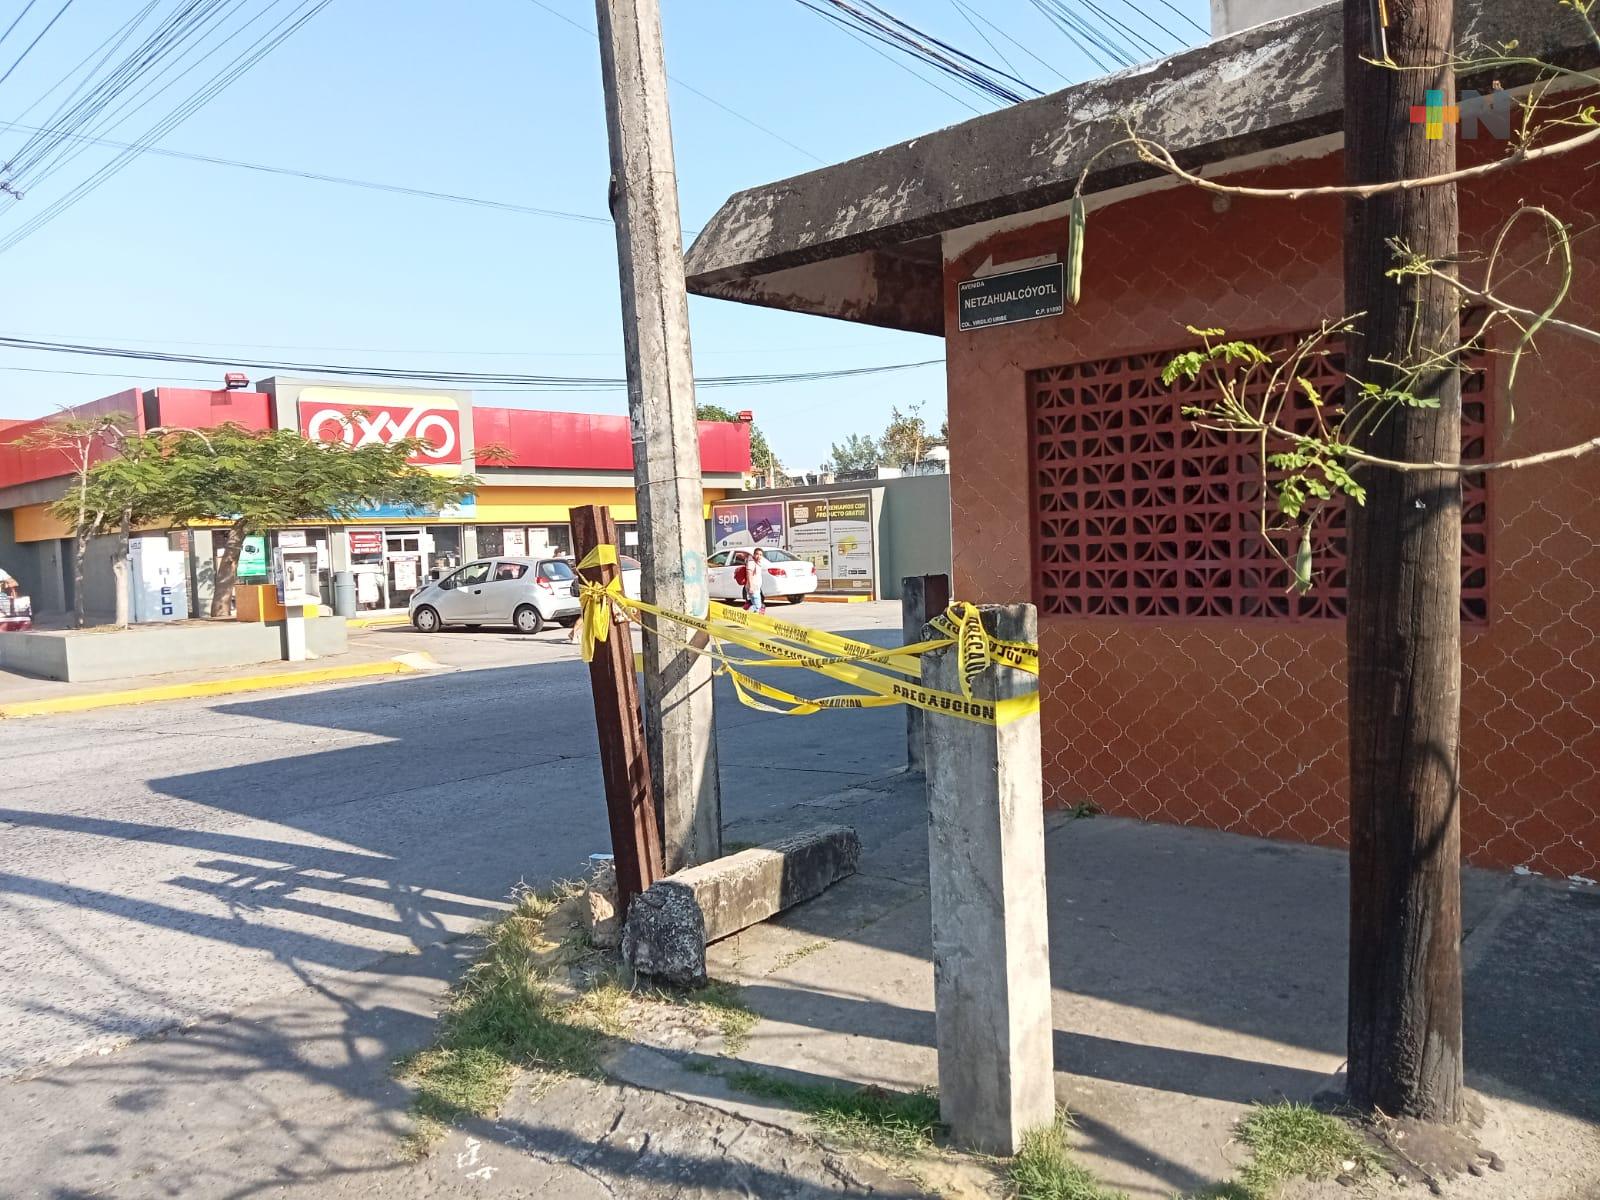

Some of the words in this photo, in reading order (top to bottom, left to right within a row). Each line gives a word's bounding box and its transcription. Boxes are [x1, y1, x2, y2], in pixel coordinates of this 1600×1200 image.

[961, 280, 985, 291] AVENIDA
[964, 283, 1057, 309] NETZAHUALCÓYOTL
[308, 406, 456, 459] OXXO
[718, 511, 739, 527] spin
[159, 567, 173, 615] HIELO
[893, 683, 996, 721] PRECAUCION
